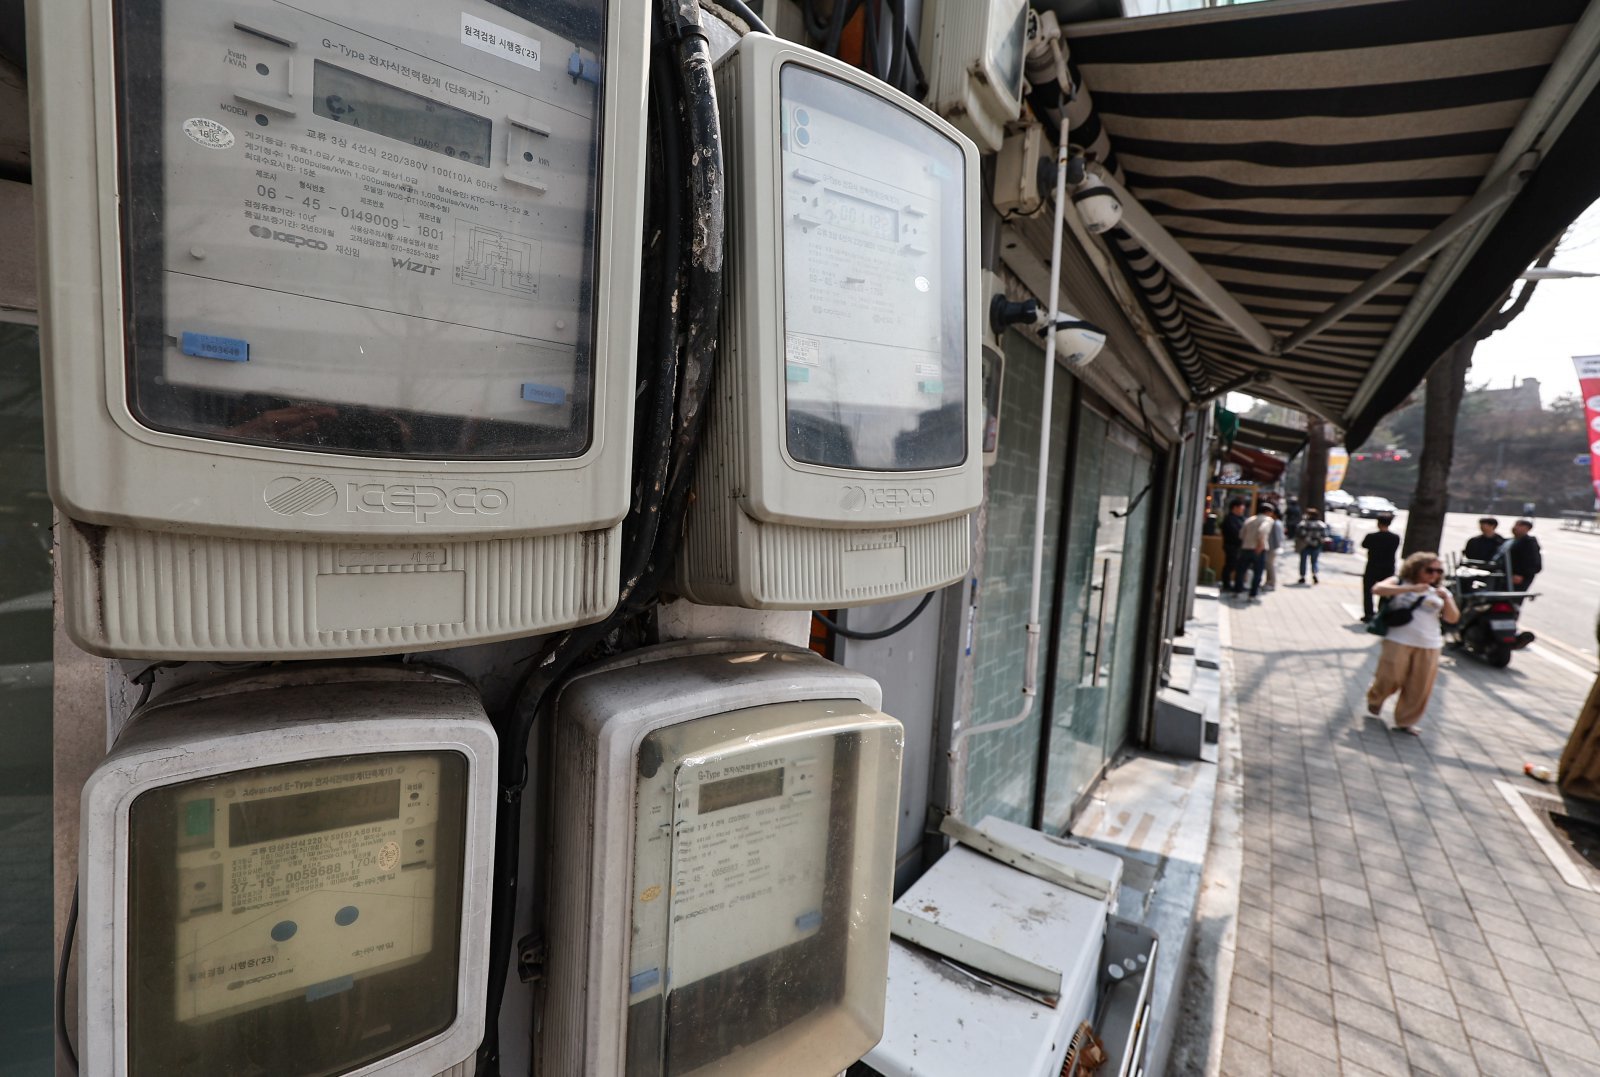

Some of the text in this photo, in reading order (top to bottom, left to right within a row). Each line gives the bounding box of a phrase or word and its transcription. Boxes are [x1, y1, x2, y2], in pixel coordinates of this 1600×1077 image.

[464, 25, 538, 61] 원격검침 시행중('23)
[321, 37, 490, 104] G-Type 전자식전력량계 (단독계기)
[220, 103, 248, 117] MODEM
[255, 169, 278, 182] 제조사
[306, 128, 327, 141] 교류
[331, 136, 347, 148] 3상
[351, 143, 377, 157] 4선식
[380, 150, 428, 171] 220/380V
[431, 166, 473, 185] 100(10)A
[256, 184, 277, 199] 06
[302, 196, 321, 211] 45
[341, 205, 399, 230] 0149009
[417, 224, 444, 241] 1801
